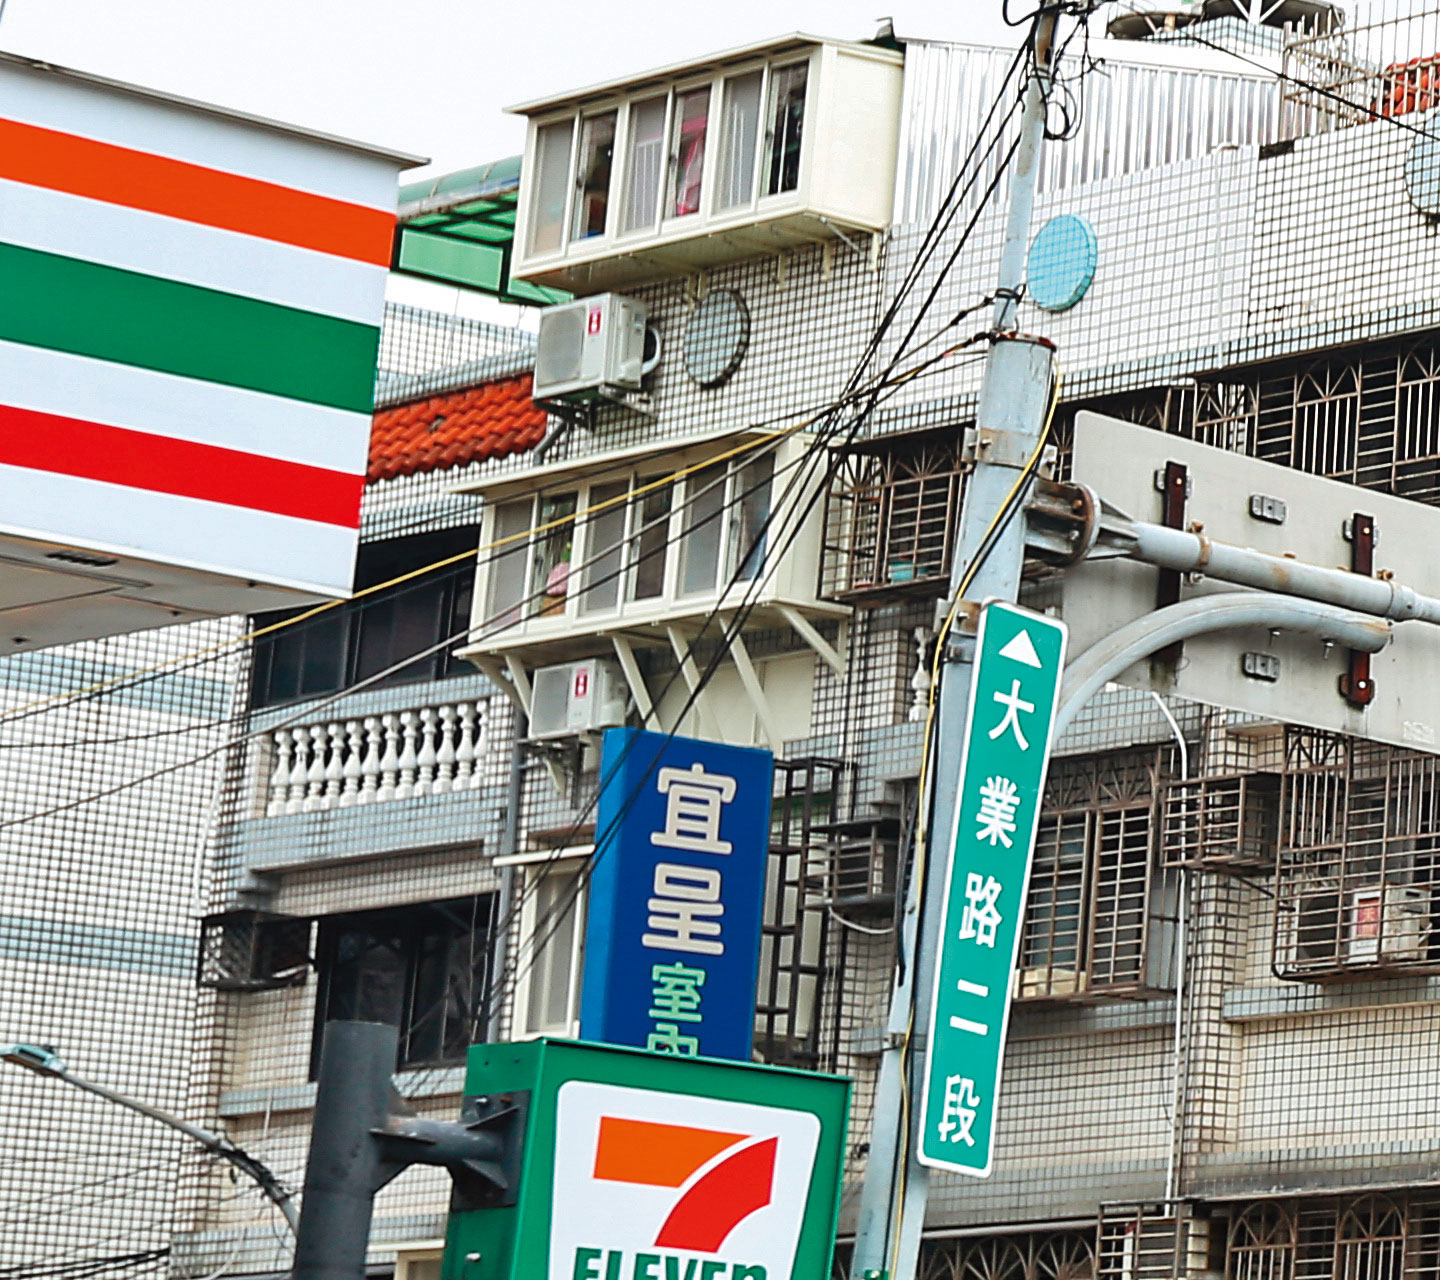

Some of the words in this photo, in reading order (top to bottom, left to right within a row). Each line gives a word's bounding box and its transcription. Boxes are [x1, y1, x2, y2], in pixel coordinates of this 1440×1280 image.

[642, 763, 737, 955] 宜呈
[937, 679, 1036, 1147] 大業路二段
